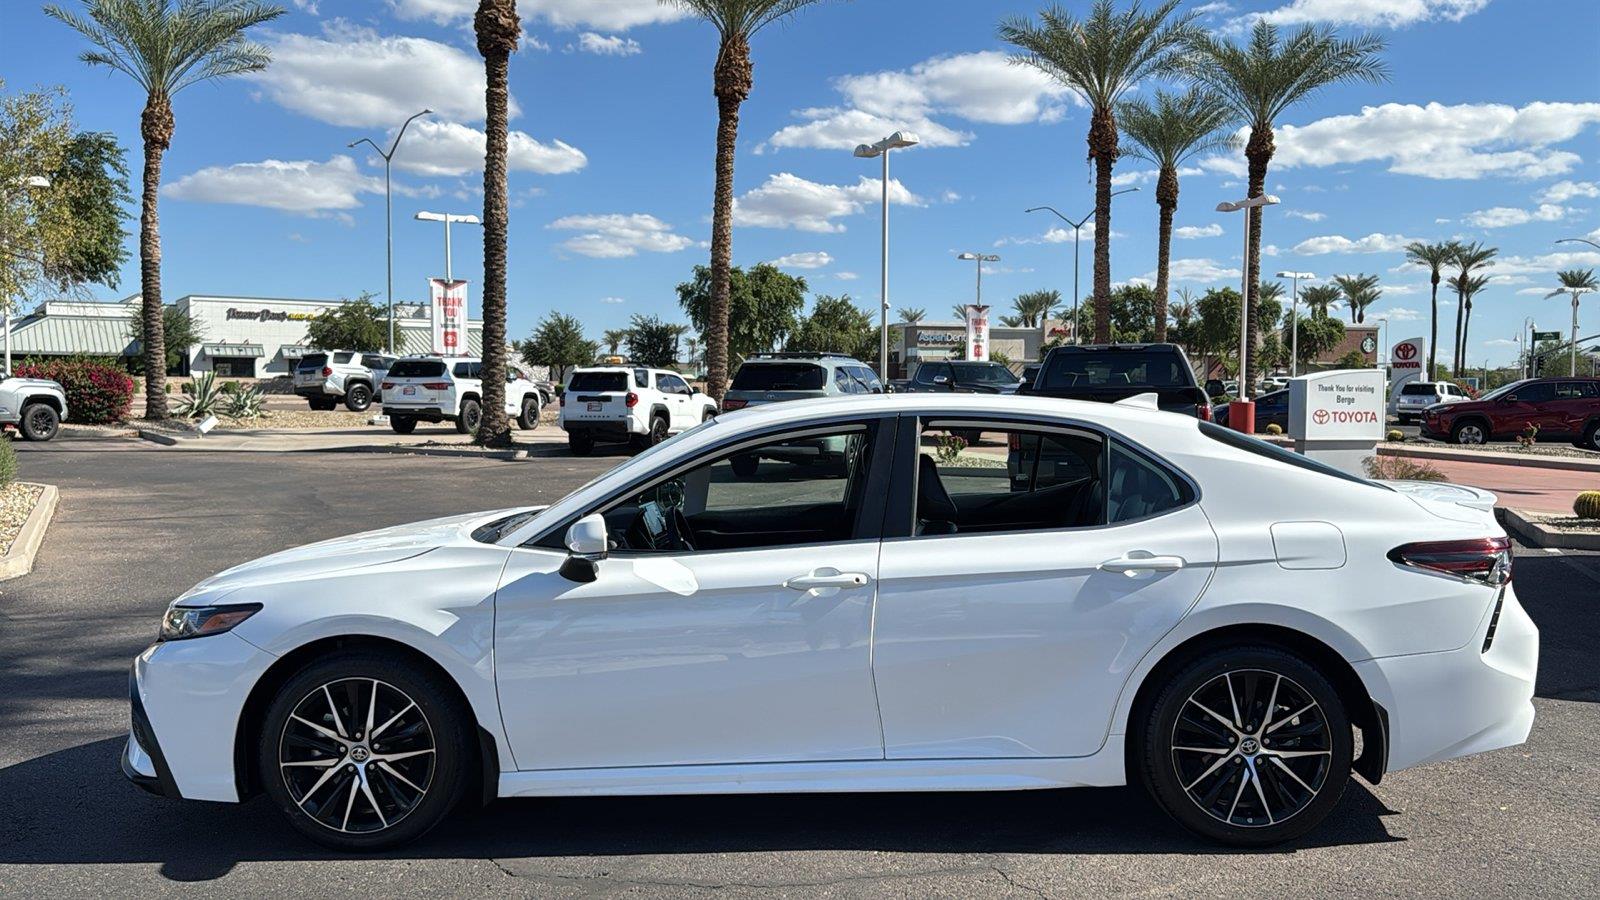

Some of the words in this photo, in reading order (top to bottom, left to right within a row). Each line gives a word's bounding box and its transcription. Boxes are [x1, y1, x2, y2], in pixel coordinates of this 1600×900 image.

[437, 296, 463, 307] THANK
[443, 307, 458, 317] YOU
[1318, 384, 1334, 392] Thank
[1335, 384, 1345, 392] You
[1346, 384, 1354, 392] for
[1355, 384, 1374, 394] visiting
[1336, 395, 1355, 405] Berge
[1331, 411, 1377, 423] TOYOTA
